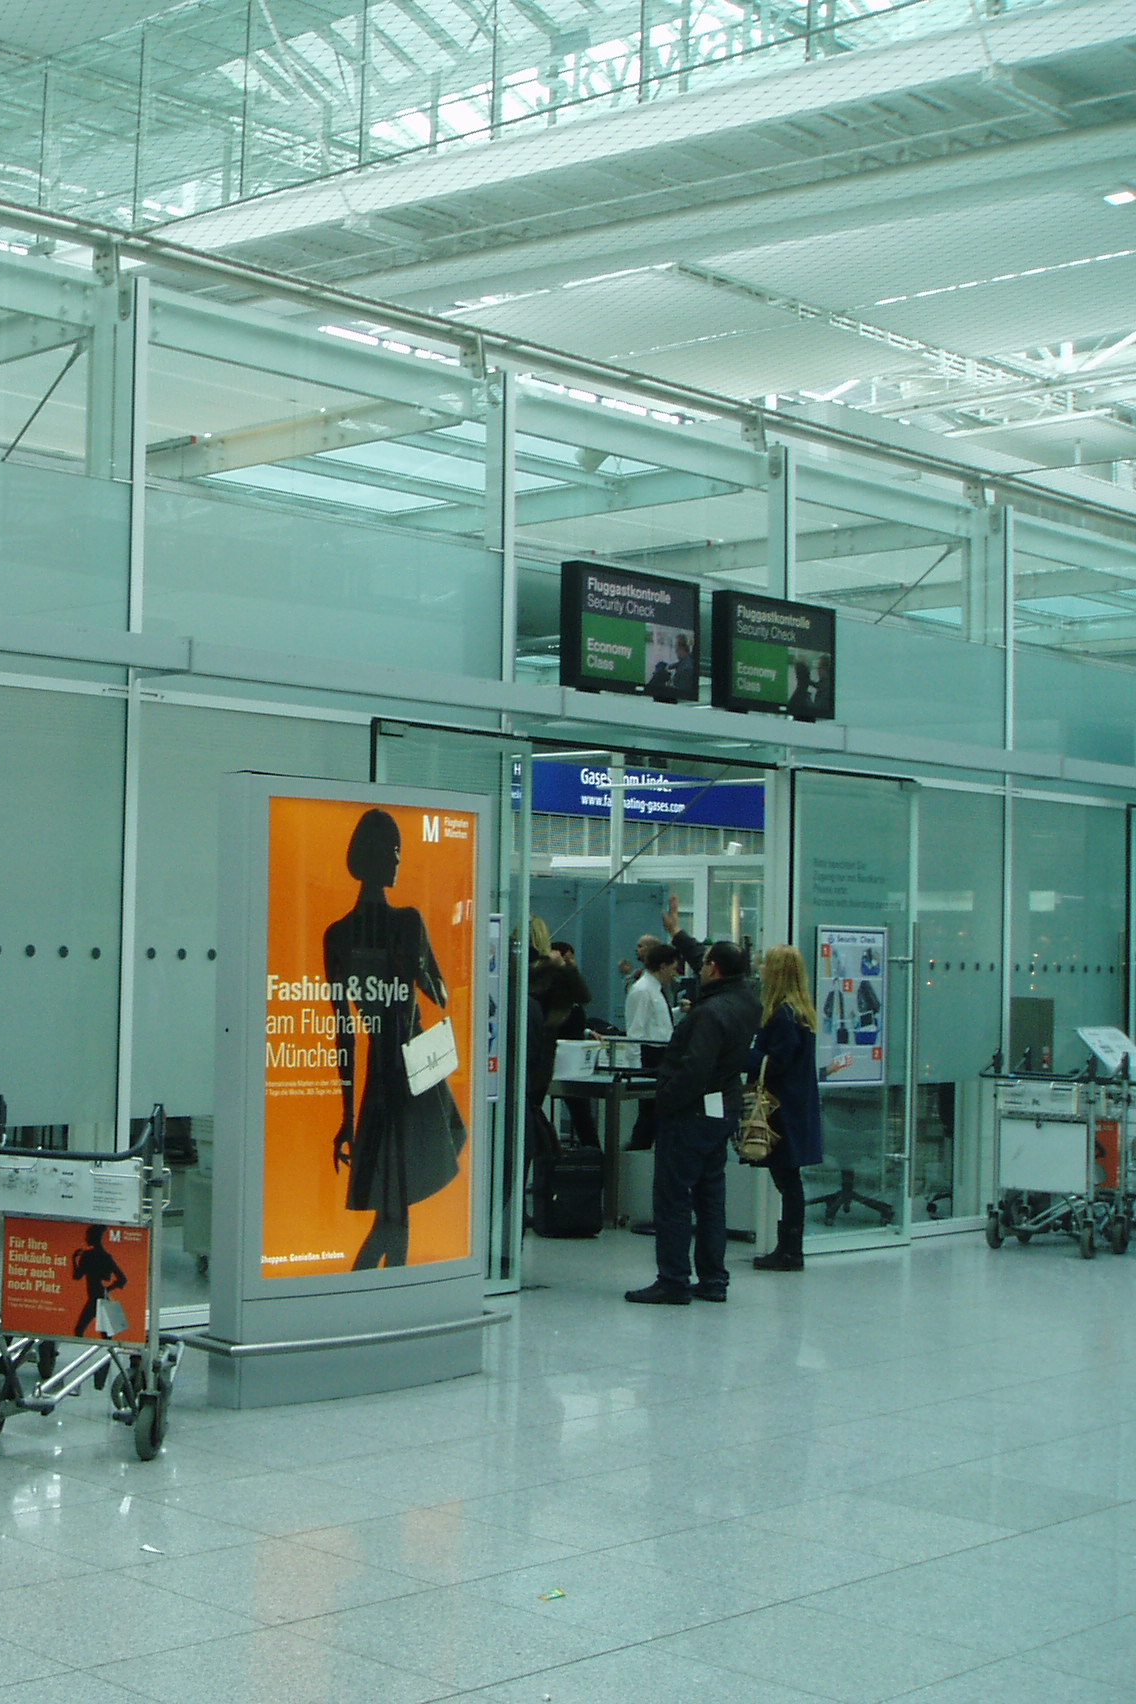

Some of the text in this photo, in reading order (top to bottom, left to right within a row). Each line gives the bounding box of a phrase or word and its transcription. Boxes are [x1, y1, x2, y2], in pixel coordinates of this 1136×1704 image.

[587, 576, 671, 605] Fluggastkontrolle
[587, 593, 655, 617] Security Check
[736, 604, 810, 629] Fluggastkontrolle
[736, 619, 796, 642] Security Check
[587, 637, 632, 659] Economy
[586, 654, 614, 671] Class
[737, 661, 776, 682] Economy
[737, 676, 761, 693] Class
[423, 814, 439, 842] M
[266, 974, 410, 1008] Fashion & Style
[266, 1008, 381, 1040] am Flughafen
[265, 1041, 348, 1068] München
[9, 1235, 48, 1251] Für Ihre
[109, 1229, 122, 1243] M
[9, 1249, 68, 1267] Einkäufe ist
[8, 1263, 56, 1279] hier auch
[7, 1279, 62, 1294] noch Platz
